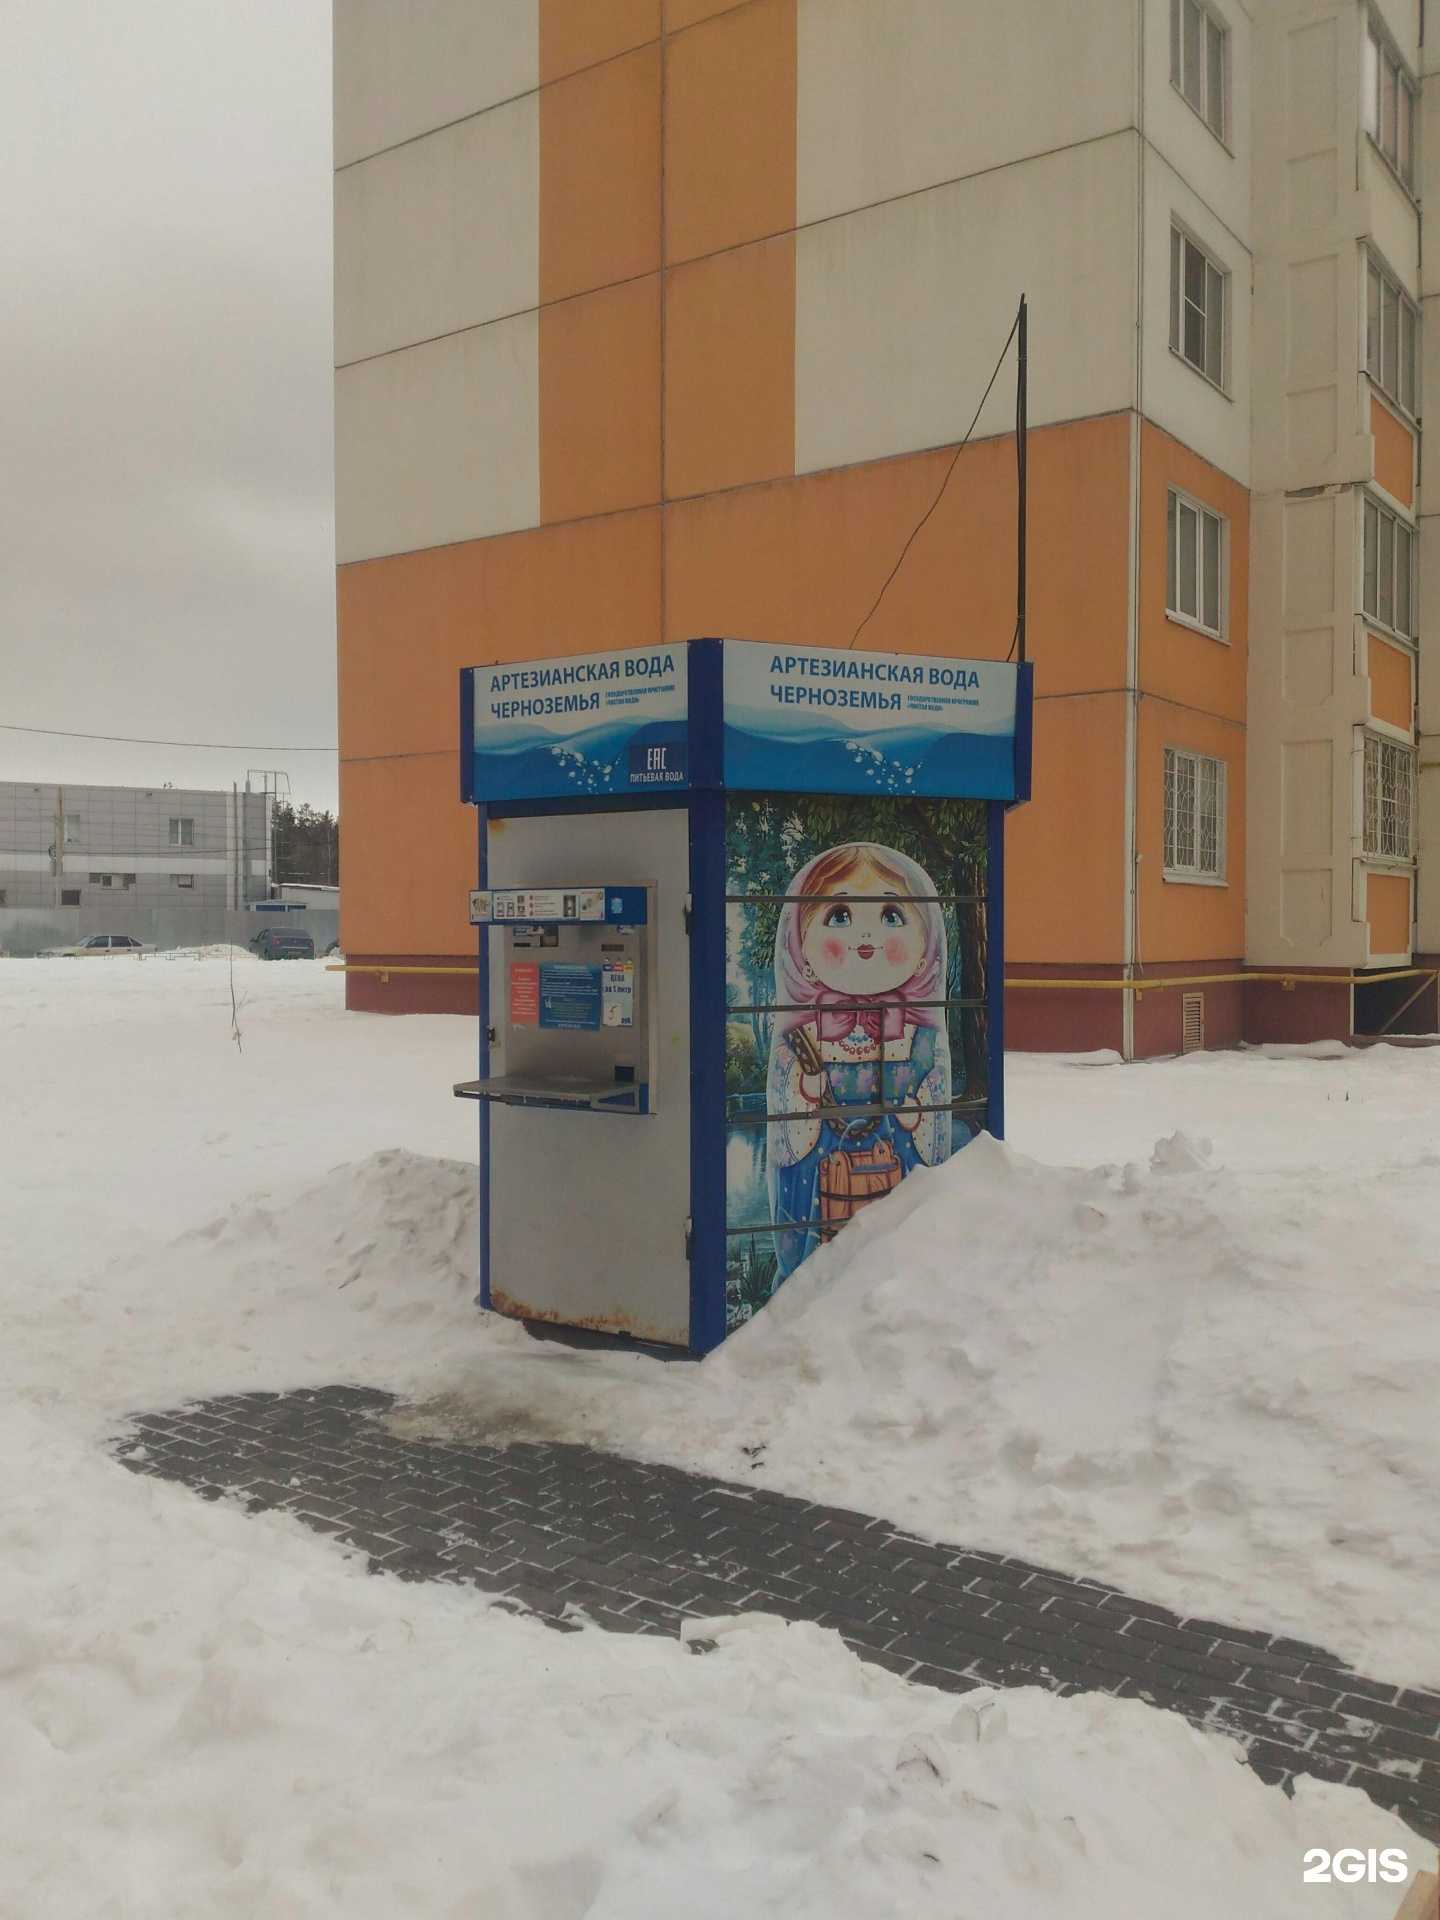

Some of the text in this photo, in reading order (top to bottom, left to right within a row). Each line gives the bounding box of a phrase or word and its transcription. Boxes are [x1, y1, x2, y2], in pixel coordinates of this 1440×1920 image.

[490, 661, 619, 692] АРТЕЗИАНСКАЯ
[625, 655, 675, 678] ВОДА
[770, 656, 979, 691] АРТЕЗИАНСКАЯ ВОДА
[491, 692, 600, 719] ЧЕРНОЗЕМЬЯ
[770, 685, 901, 711] ЧЕРНОЗЕМЬЯ
[630, 771, 684, 783] ПИТЬЕВАЯ ВОДА
